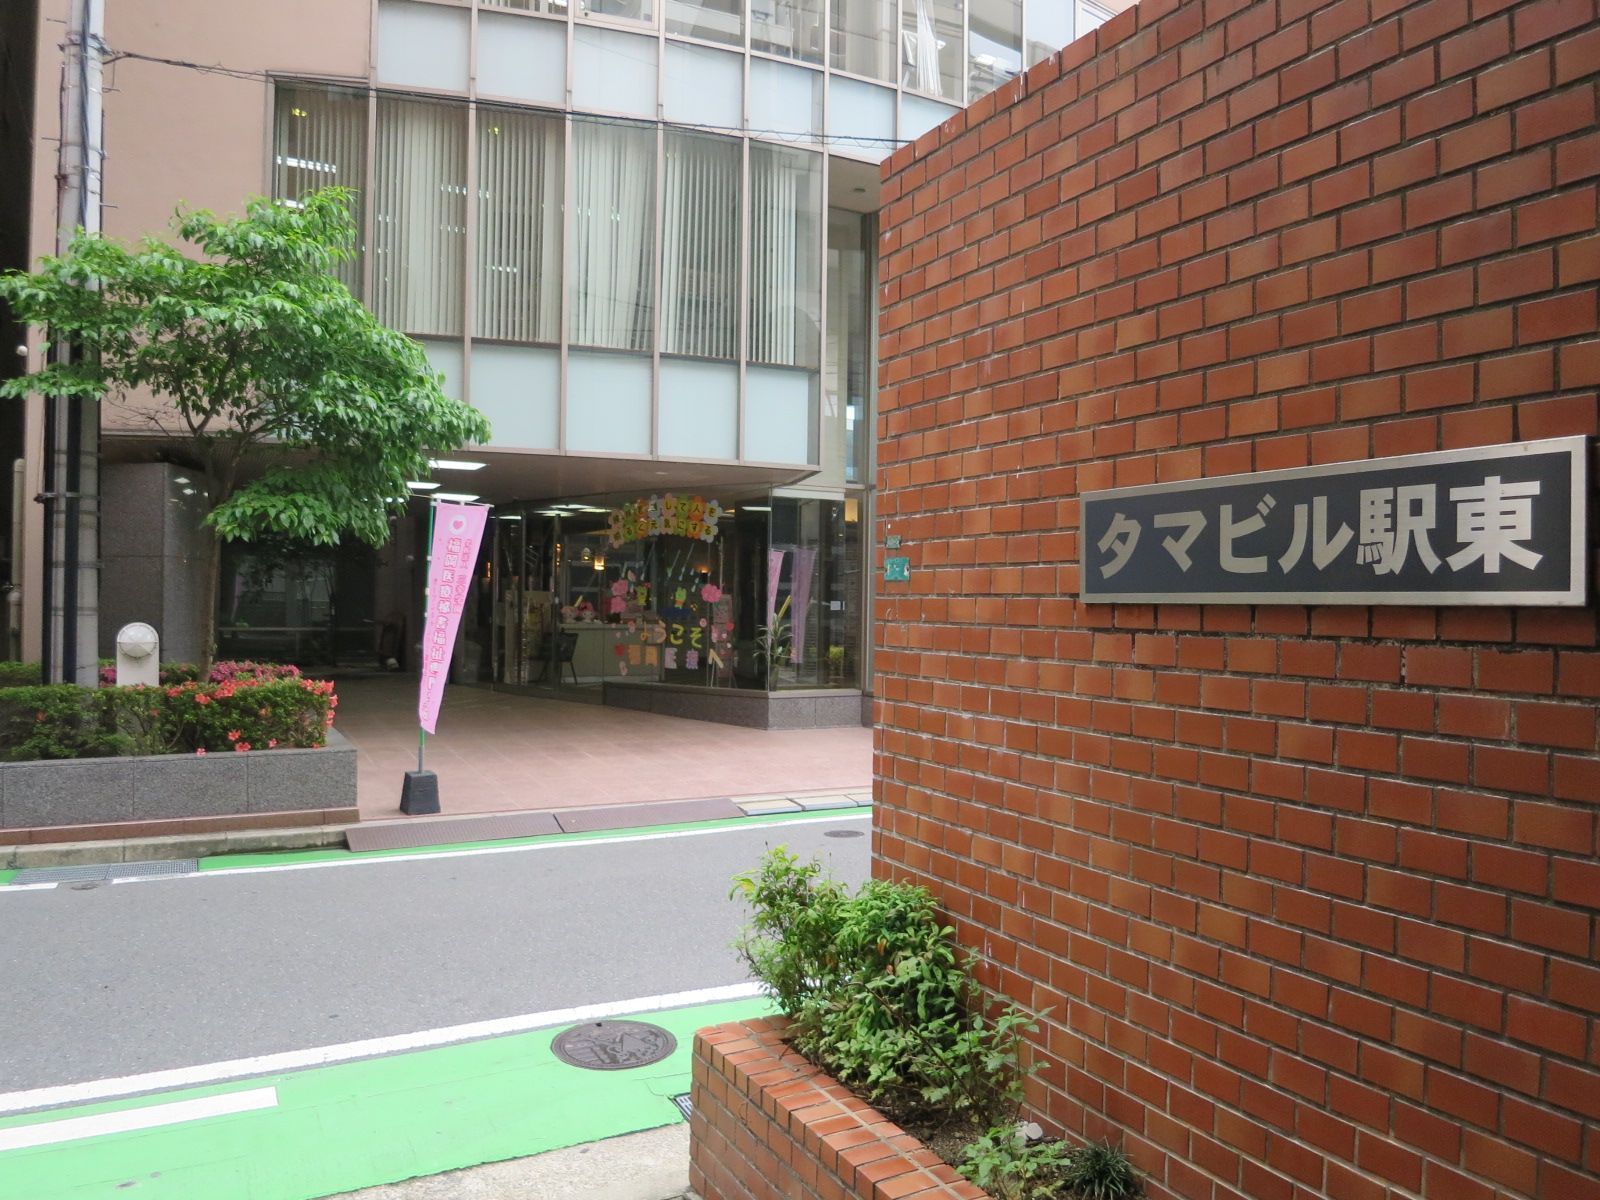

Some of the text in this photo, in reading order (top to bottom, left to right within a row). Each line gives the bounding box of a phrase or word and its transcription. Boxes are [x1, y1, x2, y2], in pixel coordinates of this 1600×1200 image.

[1096, 475, 1543, 579] タマビル駅東
[640, 619, 703, 648] ようこそ
